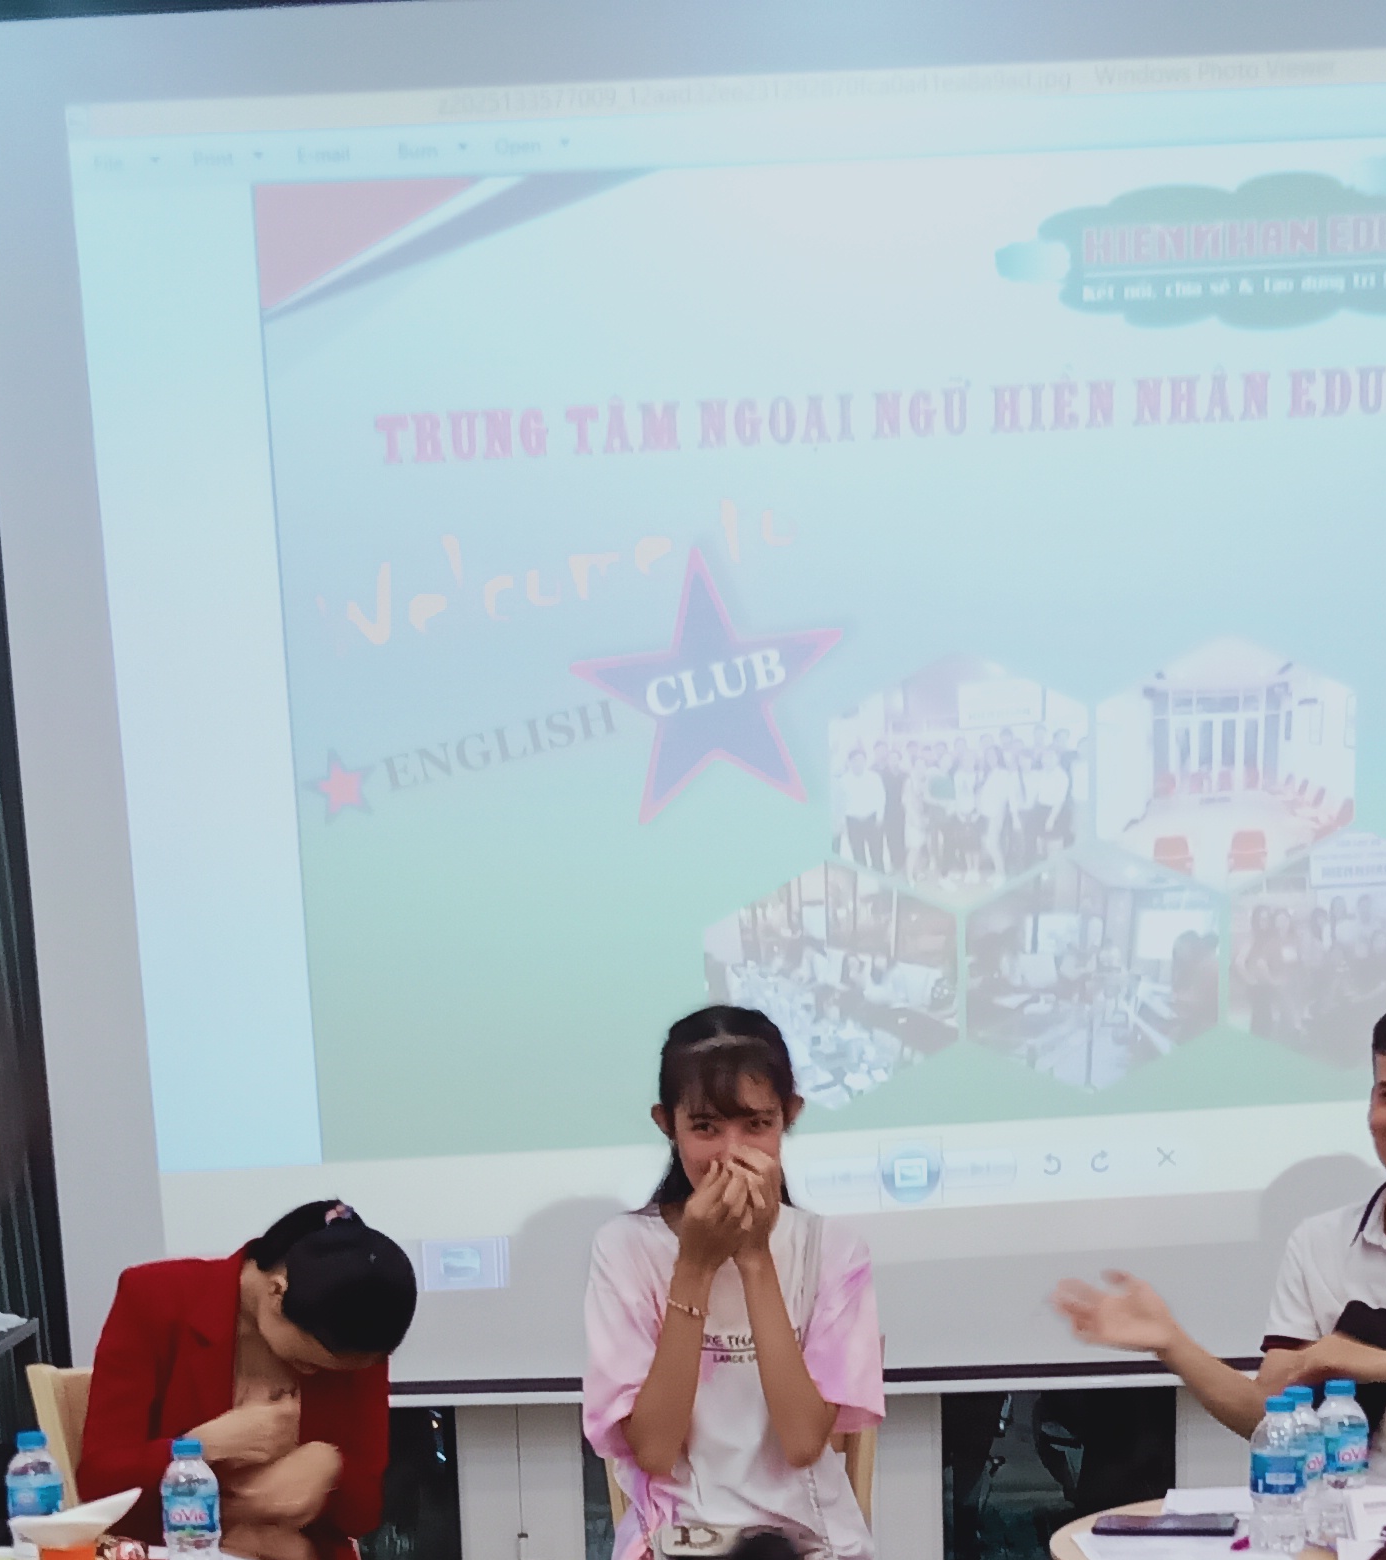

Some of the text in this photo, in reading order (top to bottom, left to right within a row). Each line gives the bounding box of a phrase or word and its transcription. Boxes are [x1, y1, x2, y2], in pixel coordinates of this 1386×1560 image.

[1095, 61, 1191, 86] Windows
[1198, 58, 1259, 81] Photo
[1266, 55, 1336, 78] Viewer
[193, 149, 234, 167] Print
[297, 145, 351, 164] E-mail
[397, 142, 439, 160] Burn
[494, 138, 542, 158] Open
[374, 406, 550, 465] TRUNG
[565, 396, 681, 455] TÂM
[698, 392, 856, 453] NGOẠI
[873, 377, 972, 440] NGỮ
[1132, 364, 1273, 427] NHÂN
[382, 647, 787, 792] ENGLISH CLUB
